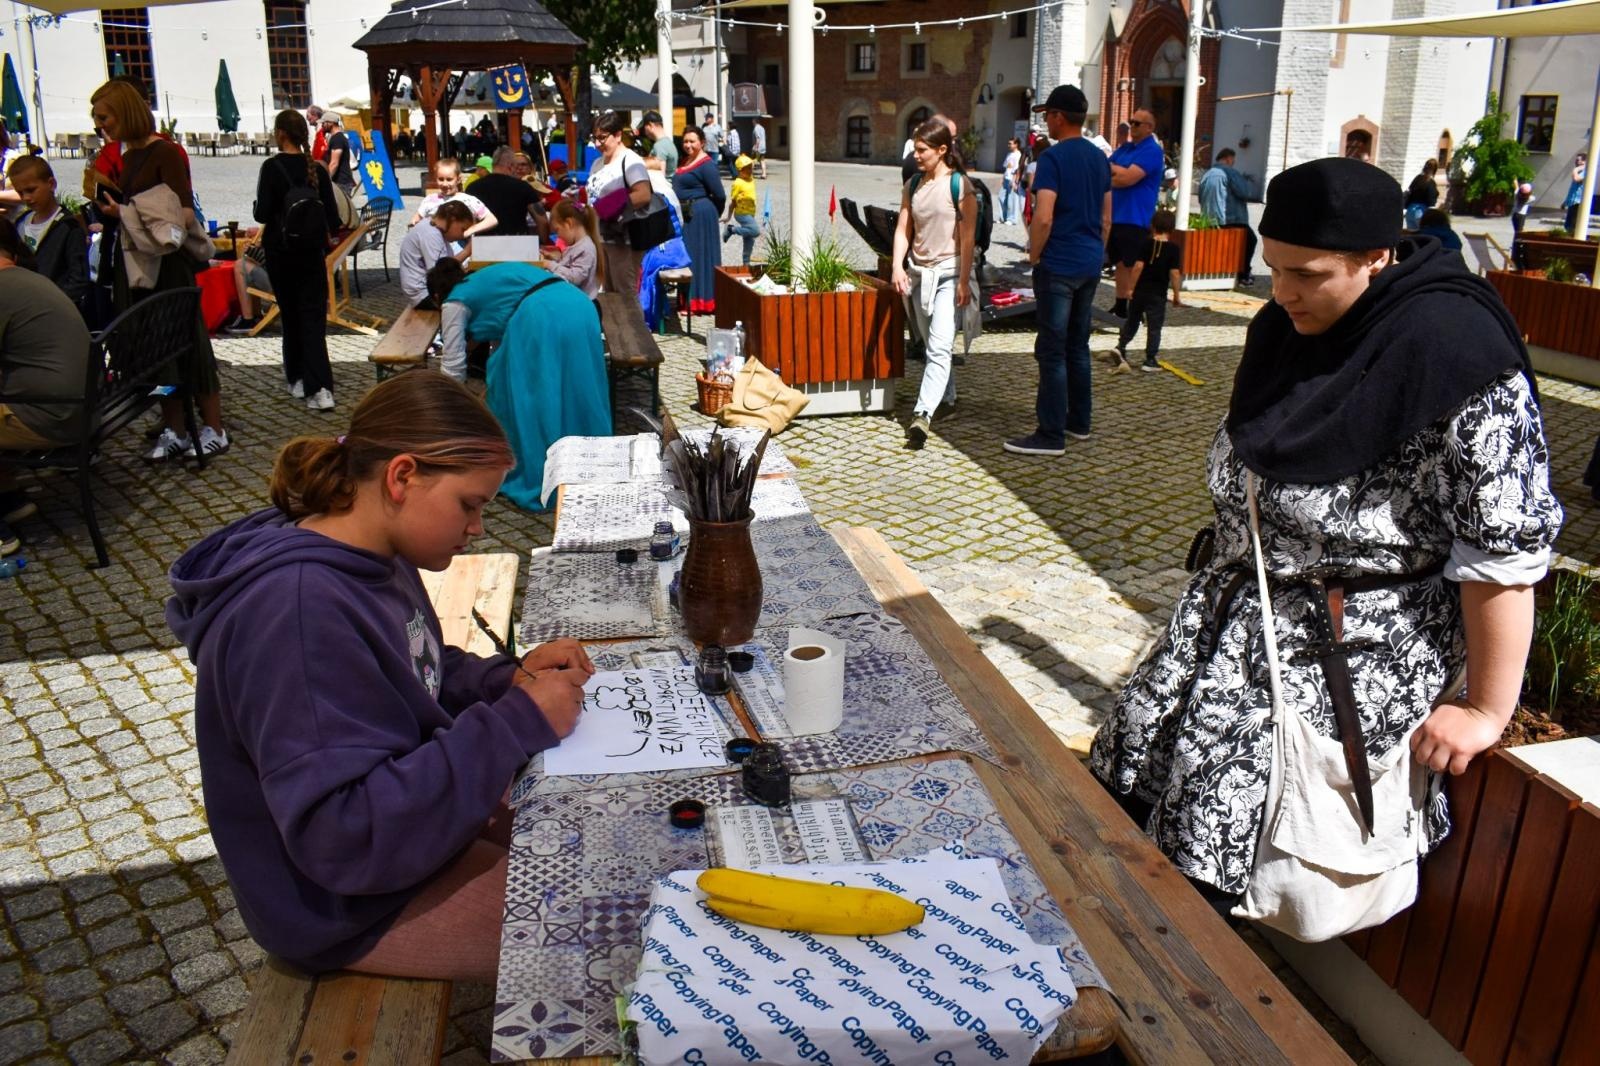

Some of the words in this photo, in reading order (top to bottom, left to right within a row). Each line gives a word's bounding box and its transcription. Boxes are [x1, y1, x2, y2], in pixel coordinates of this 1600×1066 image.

[944, 879, 983, 902] aper
[660, 905, 698, 938] Paper
[696, 900, 747, 939] Copying
[742, 934, 786, 964] Paper
[915, 897, 975, 935] Copying
[971, 927, 1020, 955] Paper
[819, 946, 866, 977] Paper
[856, 934, 917, 974] Copying
[718, 978, 752, 996] per
[786, 979, 834, 1011] Paper
[959, 976, 995, 993] per
[1027, 972, 1073, 1009] Paper
[639, 993, 679, 1038] Paper
[666, 971, 722, 1020] Copying
[715, 1014, 762, 1062] Paper
[757, 1002, 818, 1058] Copying
[838, 978, 887, 1007] pying
[882, 1000, 932, 1044] Paper
[907, 978, 972, 1026] Copying
[966, 1017, 1009, 1061] Paper
